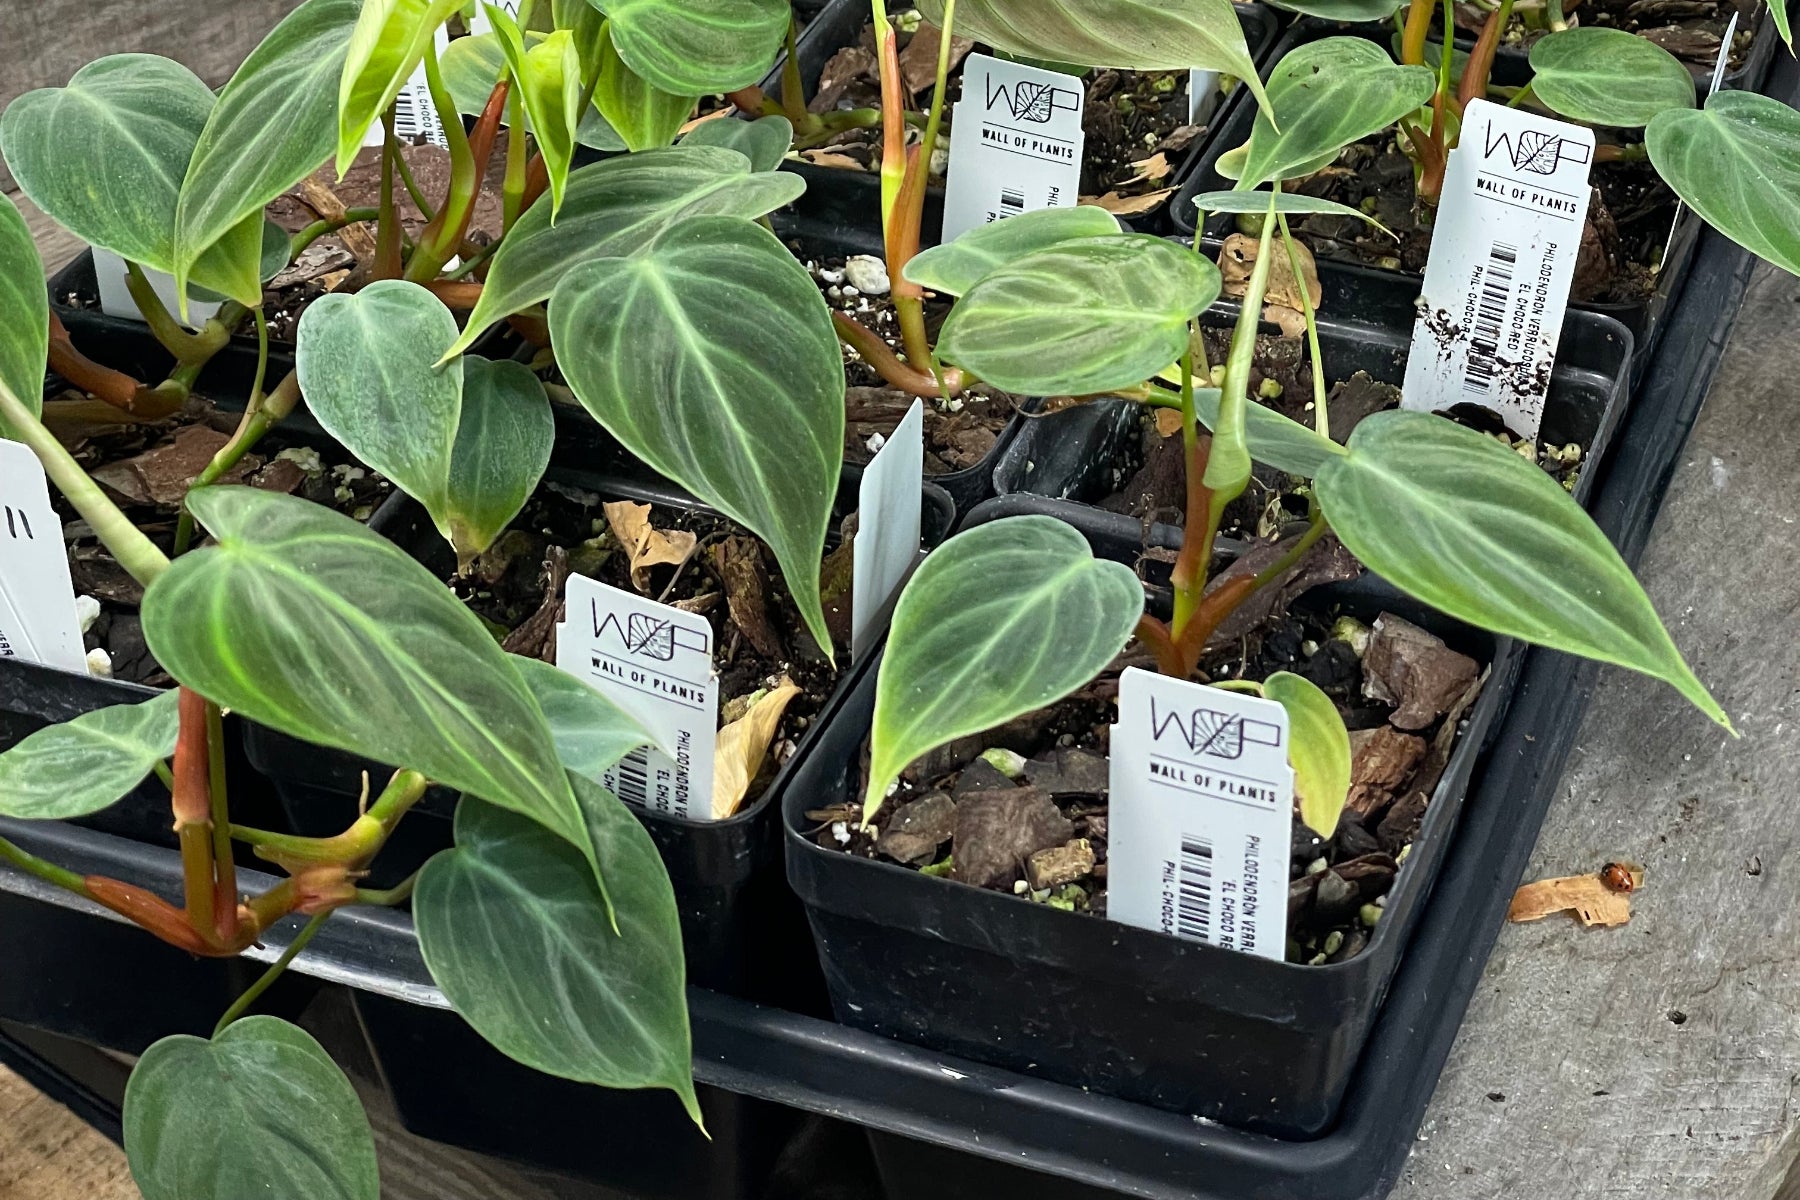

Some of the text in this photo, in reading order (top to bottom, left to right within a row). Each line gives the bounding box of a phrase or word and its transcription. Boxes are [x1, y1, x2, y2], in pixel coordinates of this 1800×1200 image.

[419, 98, 432, 128] CHOCO
[982, 128, 1073, 160] WALL OF PLANTS
[1047, 186, 1060, 208] PHIL
[1476, 178, 1577, 215] WALL OF PLANTS
[1532, 241, 1558, 316] PHILODENDRON
[1511, 297, 1528, 329] CHOCO
[591, 656, 705, 704] WALL OF PLANTS
[674, 729, 691, 804] PHILODENDRON
[1150, 761, 1277, 804] WALL OF PLANTS
[655, 783, 670, 812] CHOC
[1241, 834, 1261, 917] PHILODENDRON
[1220, 897, 1236, 933] CHOCO
